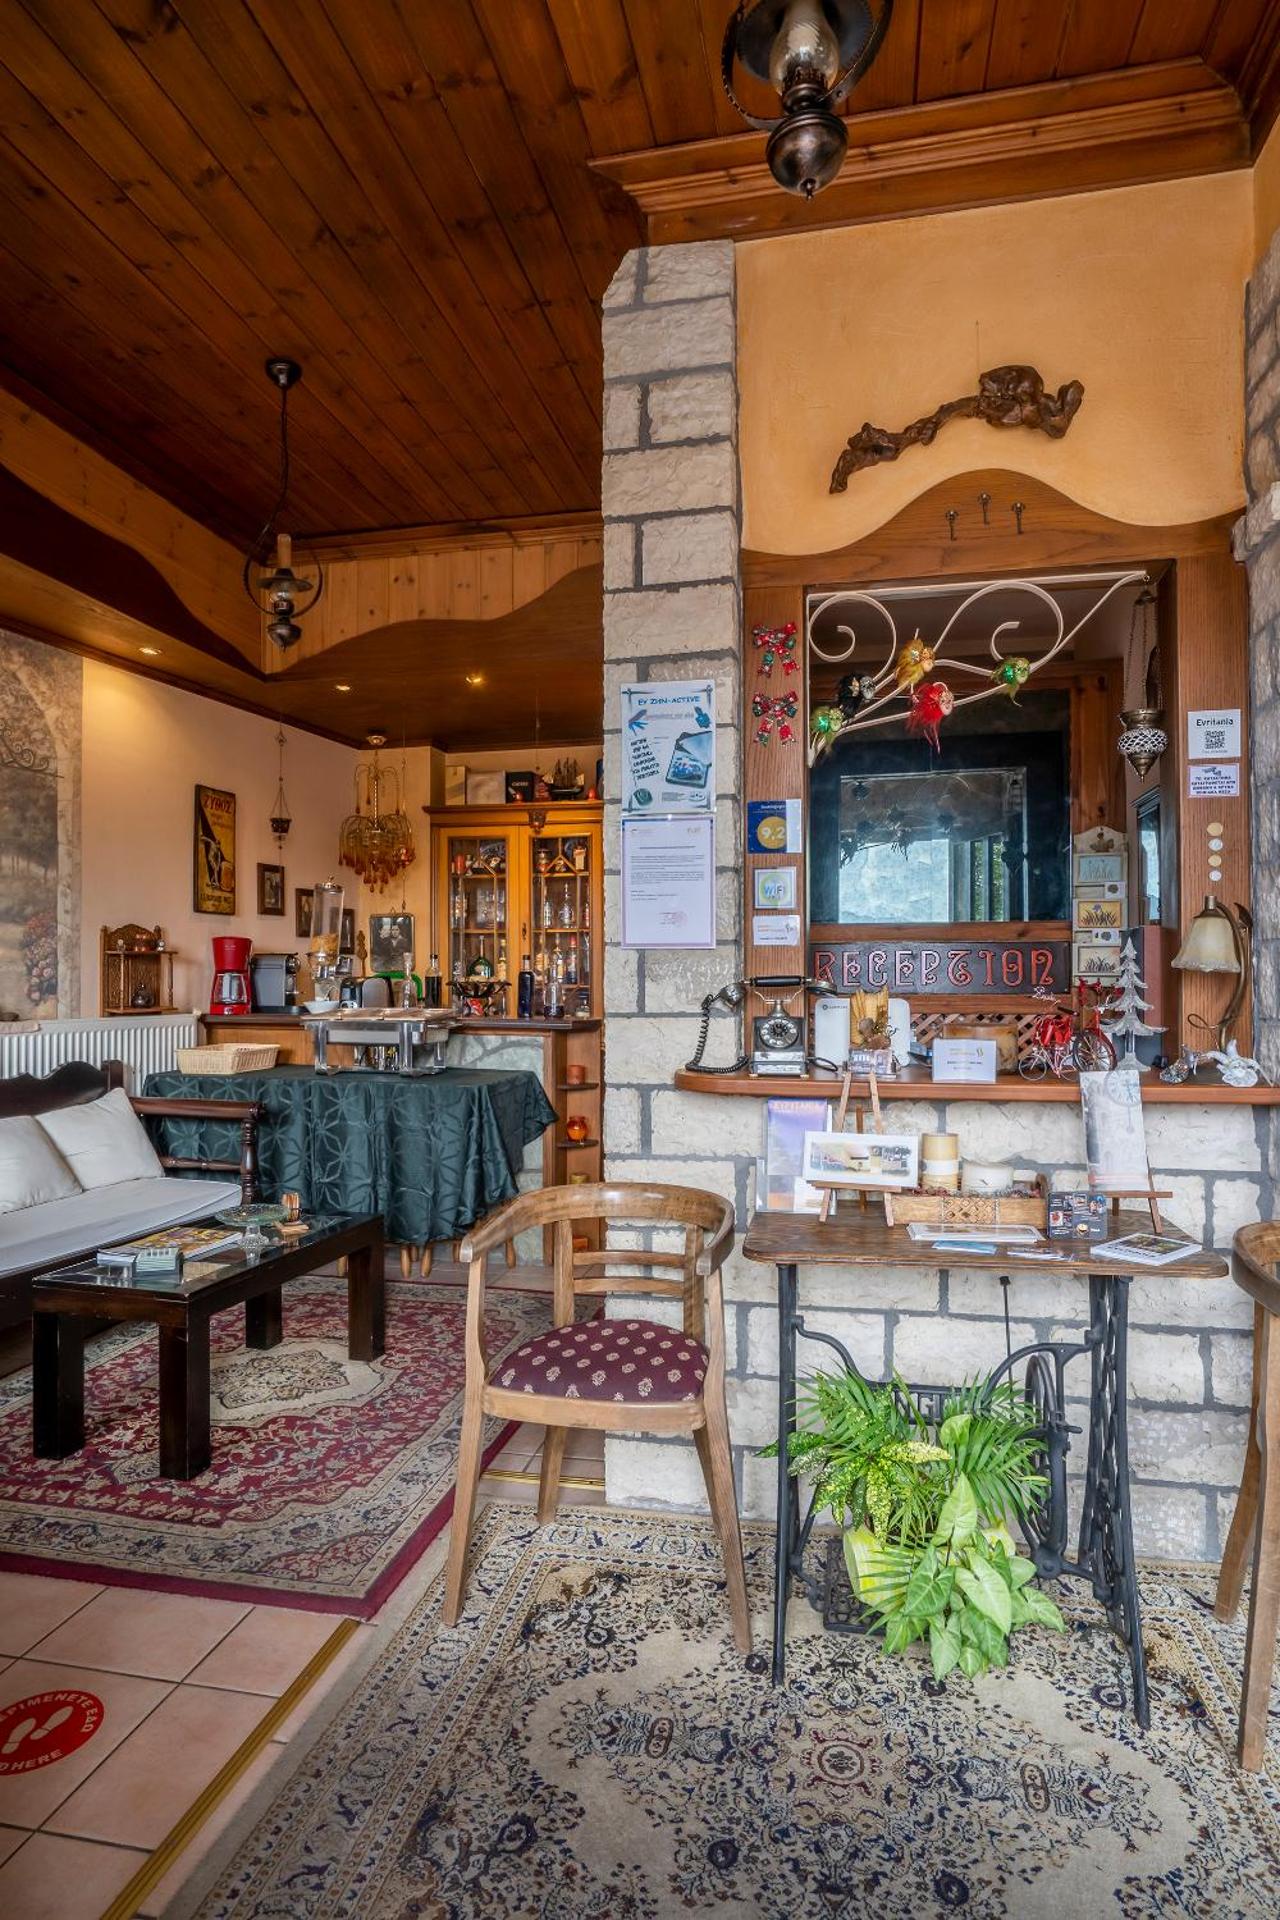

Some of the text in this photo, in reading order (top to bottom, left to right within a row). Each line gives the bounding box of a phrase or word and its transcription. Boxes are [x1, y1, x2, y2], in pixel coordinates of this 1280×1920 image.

[1196, 718, 1233, 726] Evritania
[814, 949, 1055, 988] RECEPTION
[11, 1749, 62, 1770] HERE
